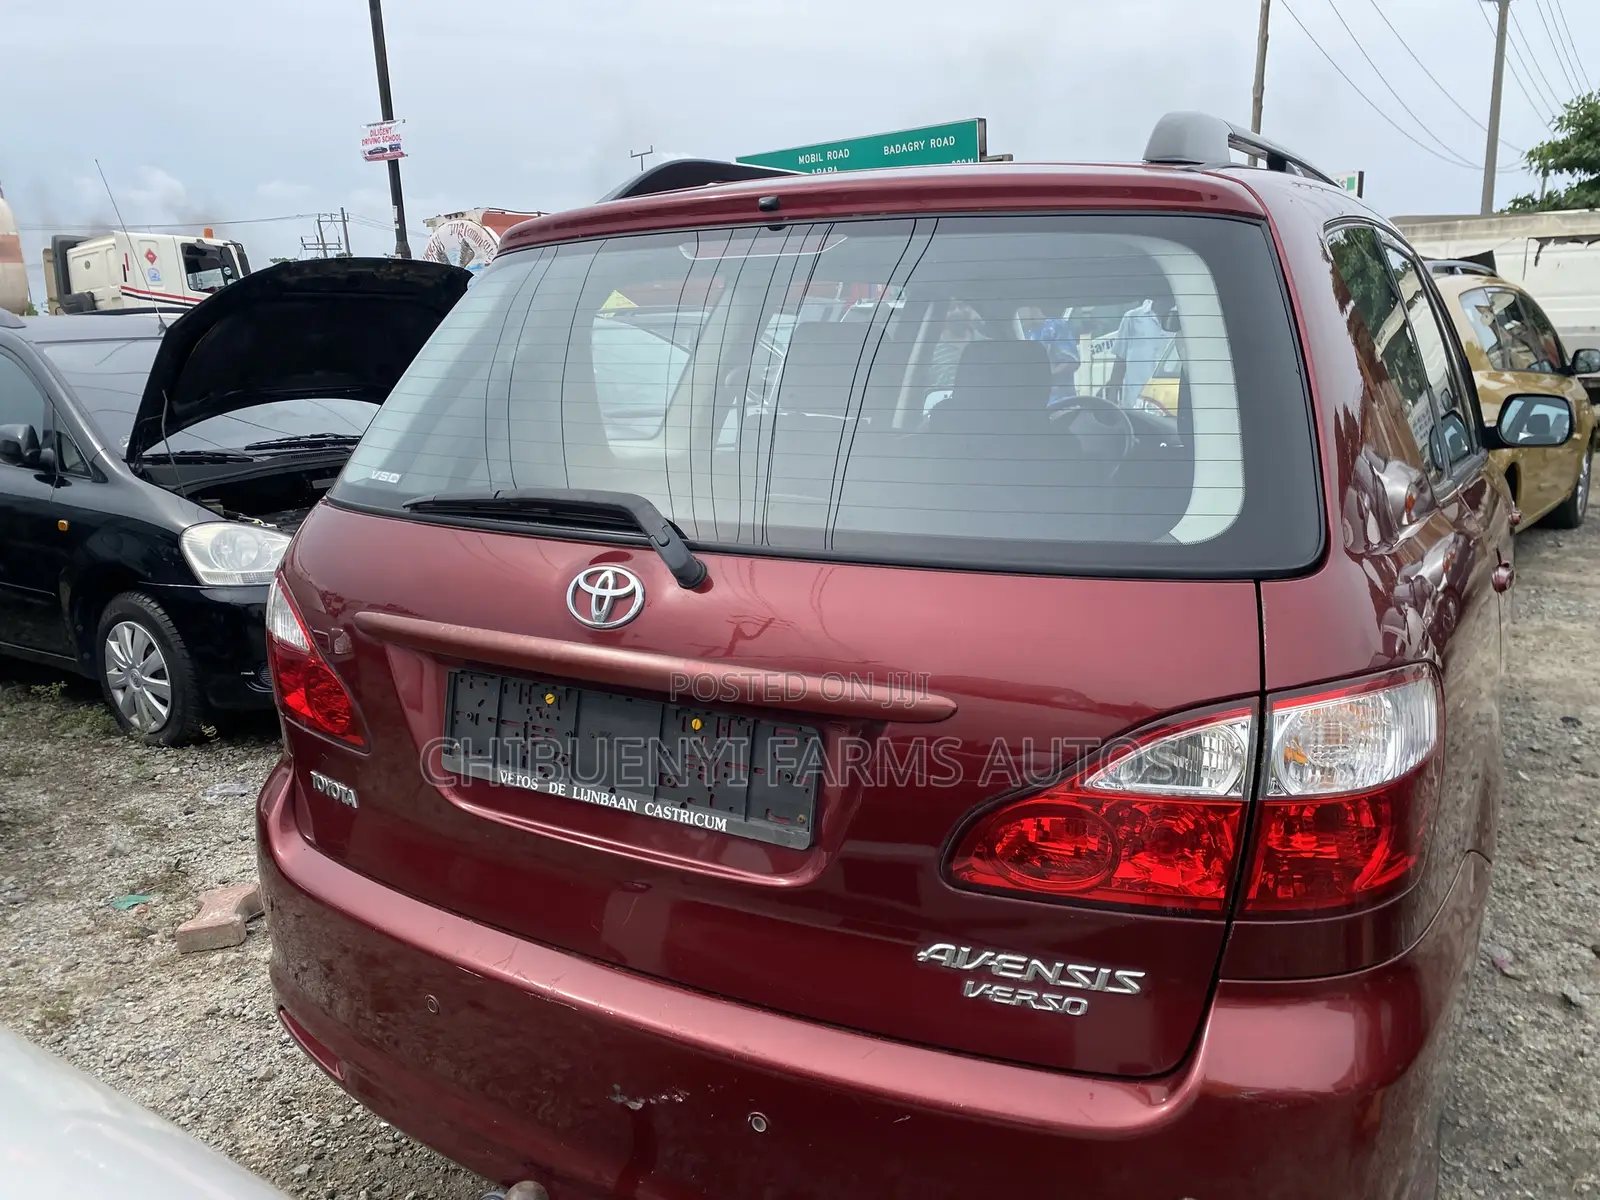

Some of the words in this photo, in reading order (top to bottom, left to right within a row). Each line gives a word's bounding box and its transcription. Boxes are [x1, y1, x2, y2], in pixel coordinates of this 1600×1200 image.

[361, 136, 381, 146] DRIVING
[382, 133, 402, 143] SCHOOL
[798, 153, 824, 165] MOBIL
[826, 148, 850, 161] ROAD
[883, 140, 925, 155] BADAGRY
[930, 135, 955, 149] ROAD
[309, 769, 359, 809] TOYOTA
[548, 781, 566, 797] DE
[572, 786, 638, 812] LIJNBAAN
[644, 802, 728, 832] CASTRICUM
[916, 942, 1146, 994] AVENSIS
[962, 980, 1088, 1016] VERSO
